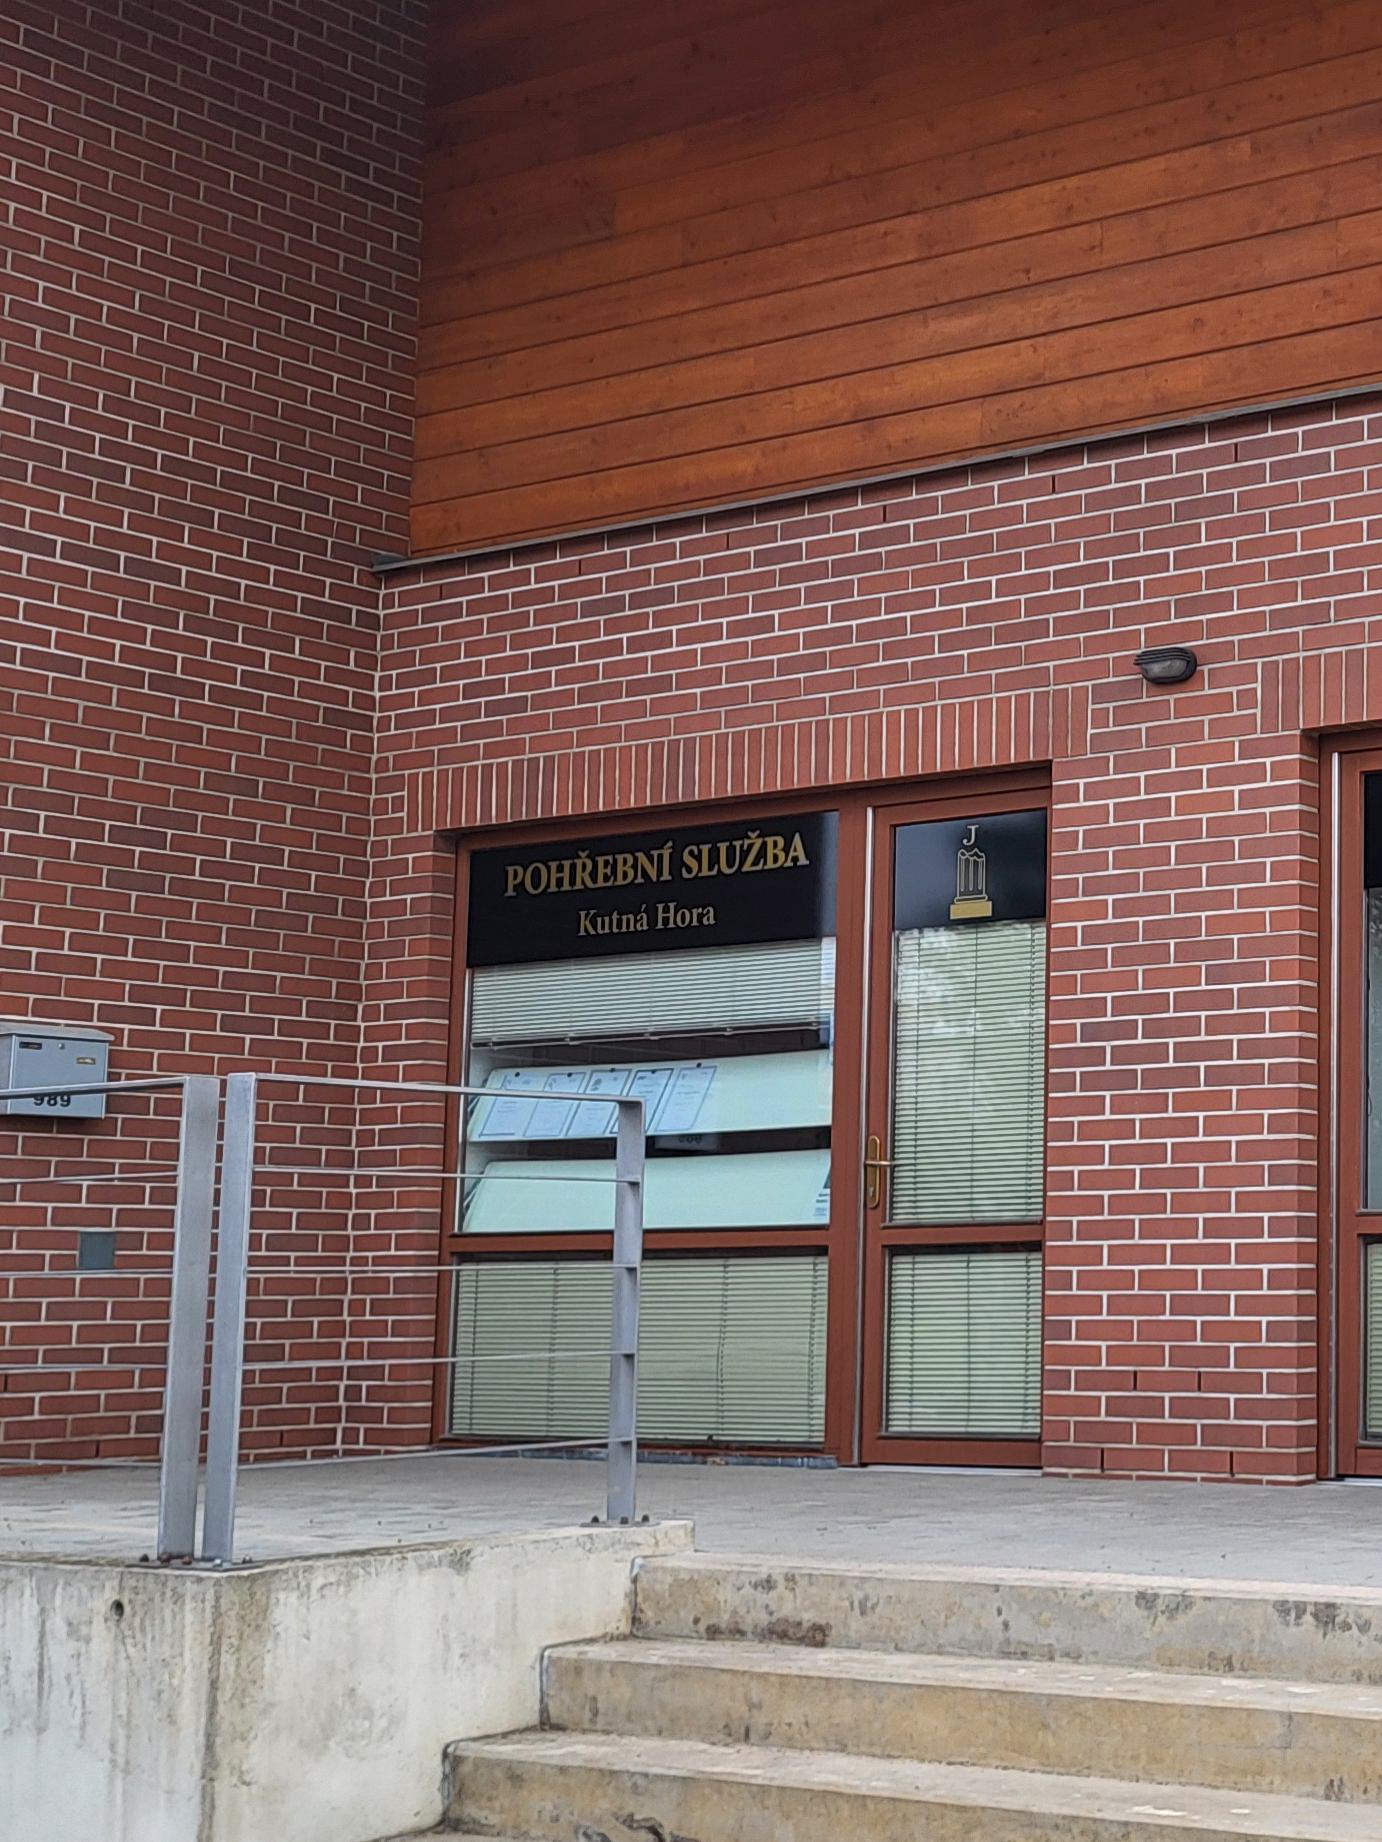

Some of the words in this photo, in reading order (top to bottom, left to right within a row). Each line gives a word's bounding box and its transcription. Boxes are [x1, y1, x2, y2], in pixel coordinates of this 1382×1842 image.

[962, 824, 979, 846] J
[504, 841, 673, 898] POHŘEBNÍ
[682, 830, 810, 876] SLUŽBA
[577, 908, 648, 937] Kutná
[655, 902, 717, 930] Hora
